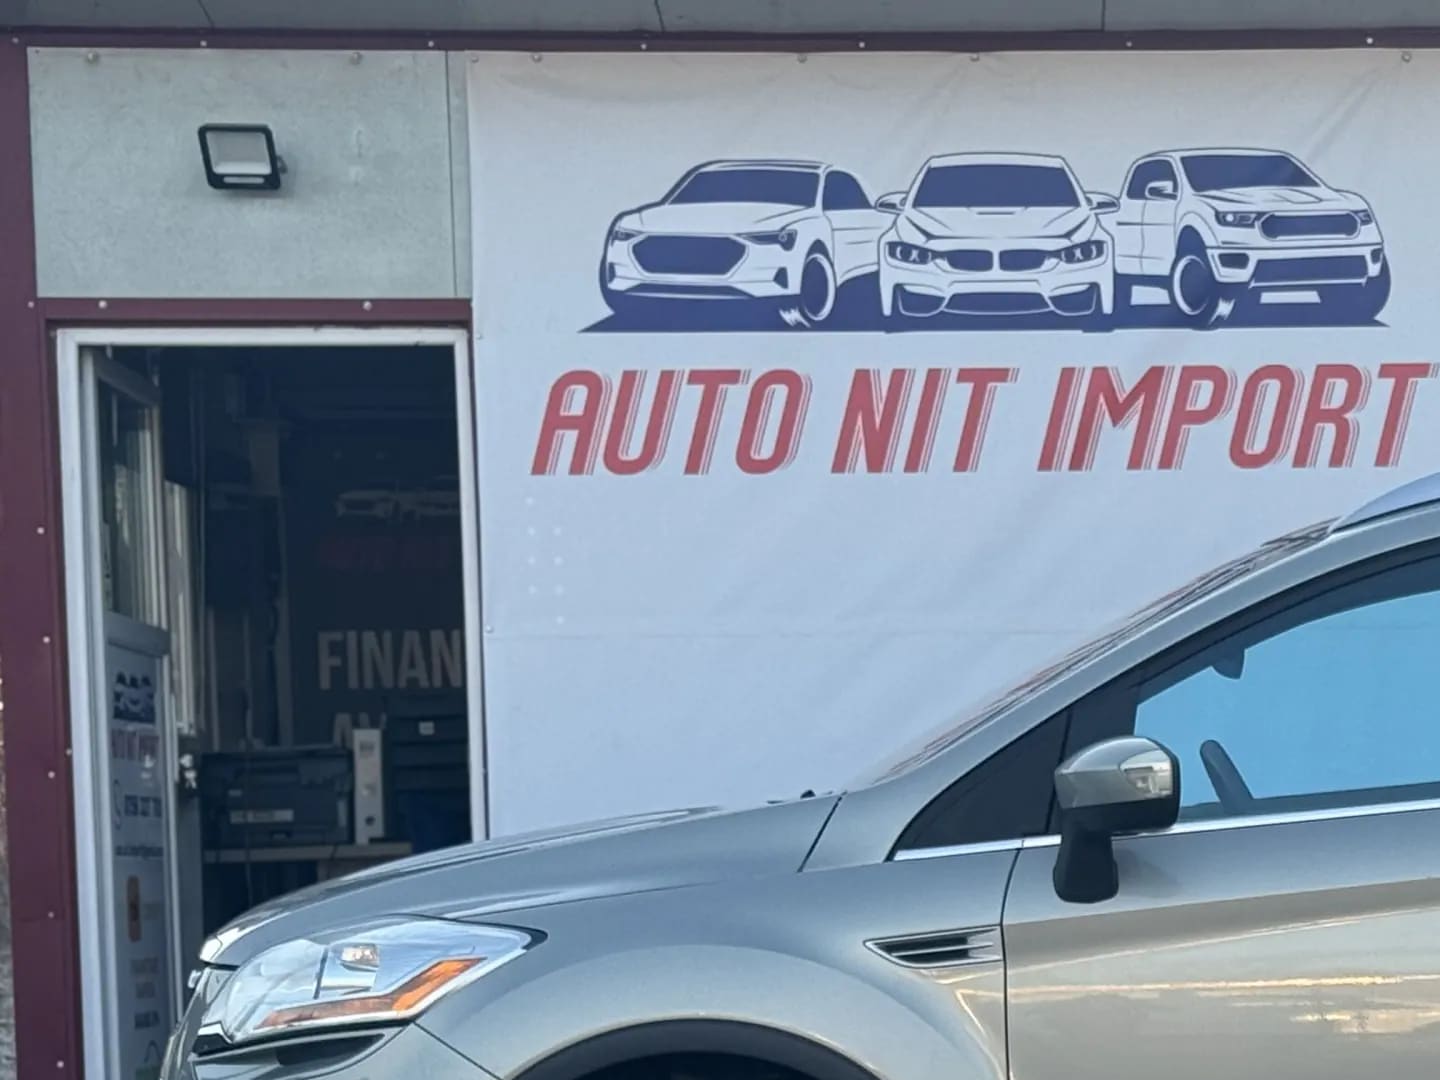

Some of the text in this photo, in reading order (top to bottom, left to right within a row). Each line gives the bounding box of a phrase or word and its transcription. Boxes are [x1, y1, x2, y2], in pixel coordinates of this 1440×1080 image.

[531, 362, 1439, 475] AUTO NIT IMPORT
